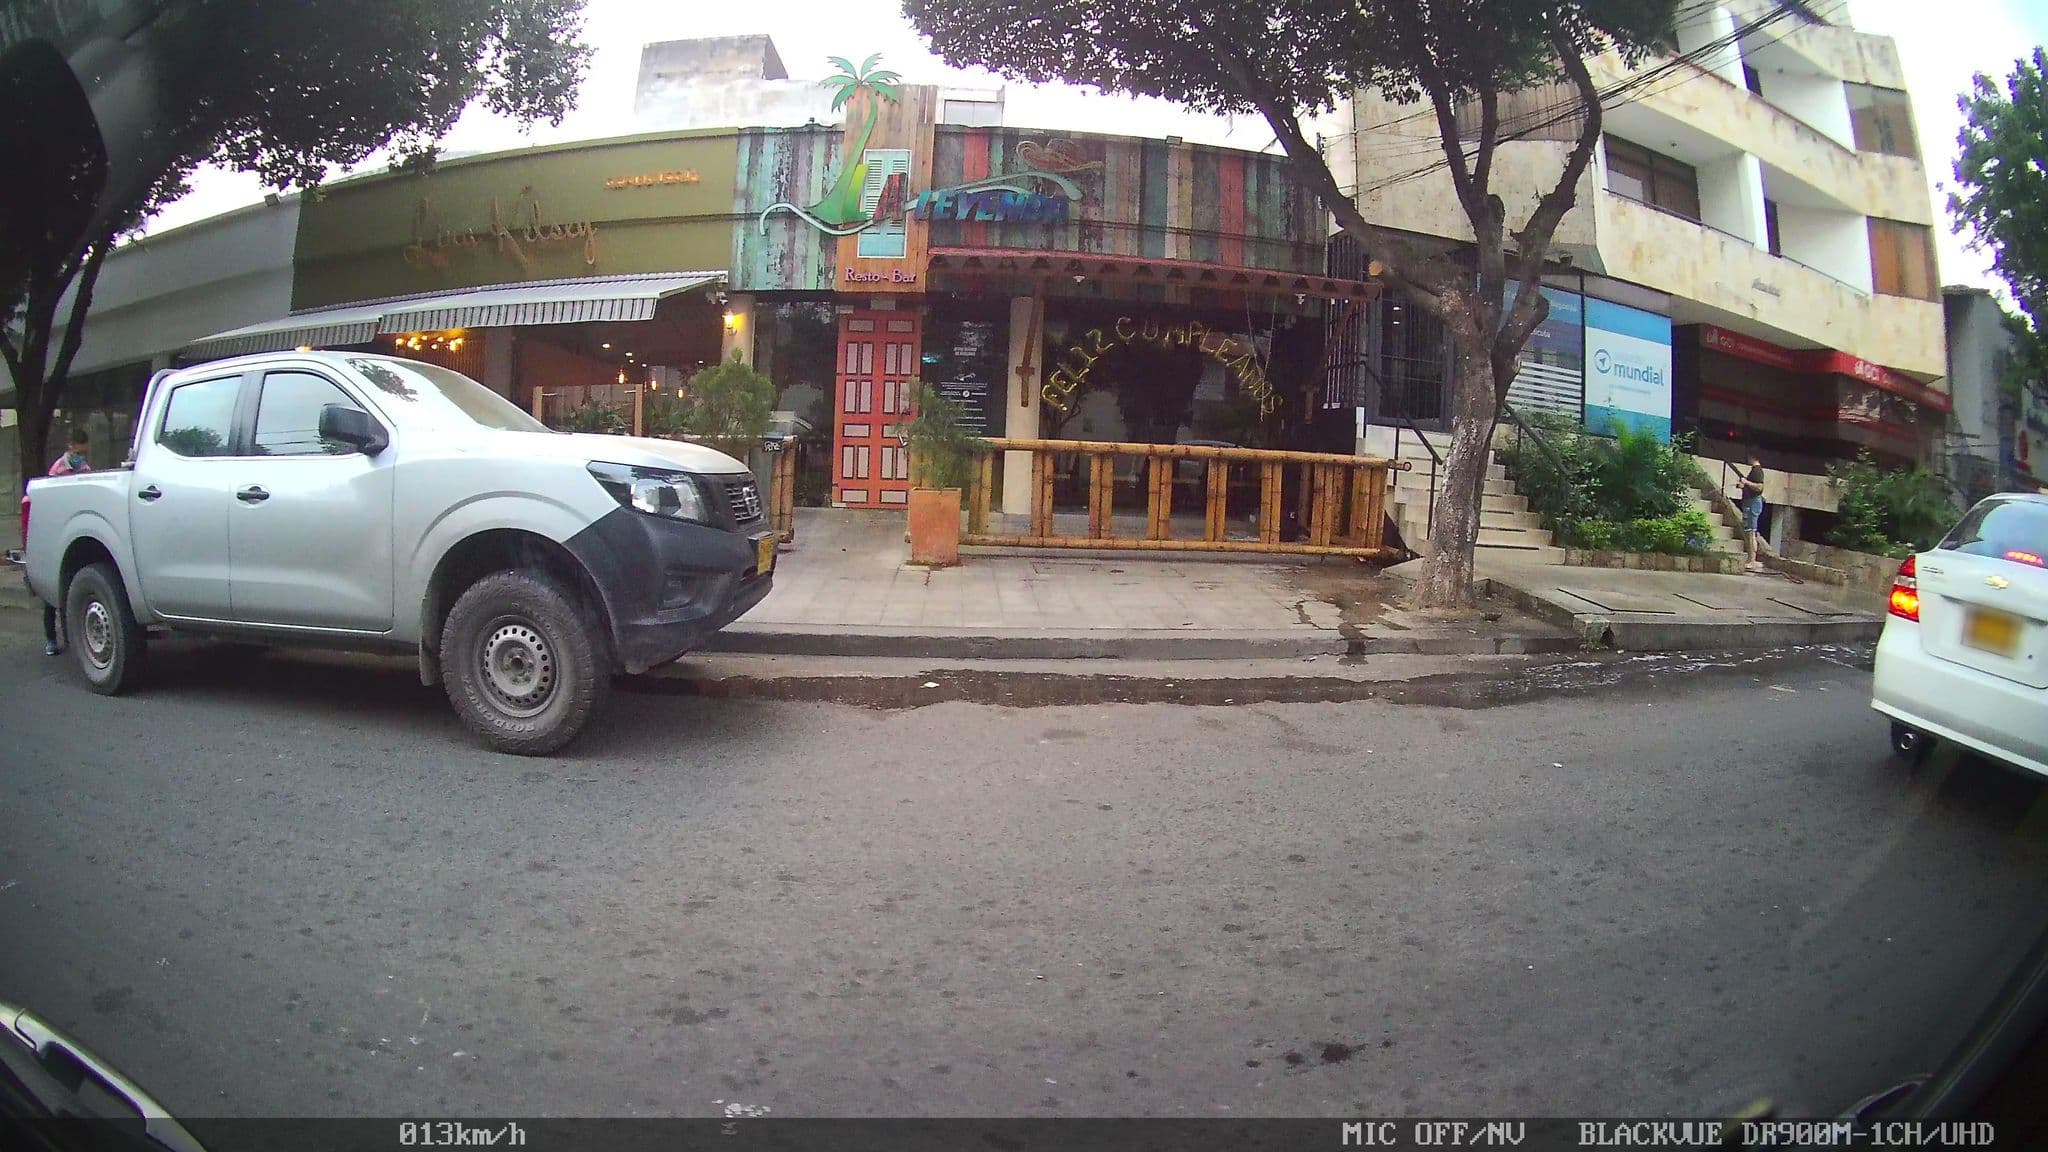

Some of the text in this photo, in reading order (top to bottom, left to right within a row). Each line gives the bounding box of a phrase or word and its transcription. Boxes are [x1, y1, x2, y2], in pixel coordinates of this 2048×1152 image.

[844, 267, 881, 282] Resto
[891, 269, 917, 283] Bar
[1613, 362, 1665, 388] mundial
